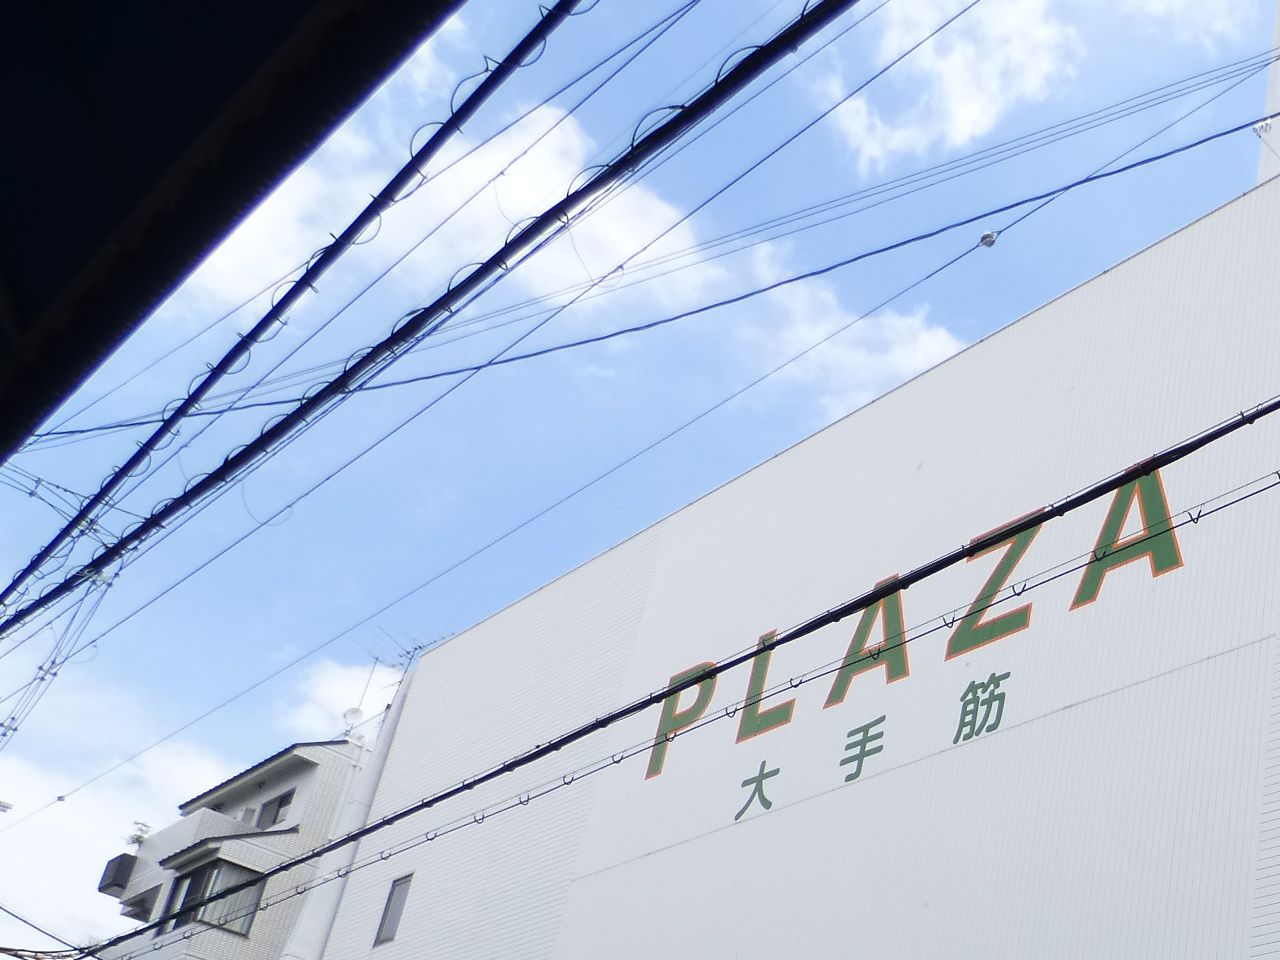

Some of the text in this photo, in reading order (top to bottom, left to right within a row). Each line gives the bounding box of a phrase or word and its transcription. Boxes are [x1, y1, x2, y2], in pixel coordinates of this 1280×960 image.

[645, 454, 1185, 781] PLAZA
[733, 671, 1011, 822] 大手筋
